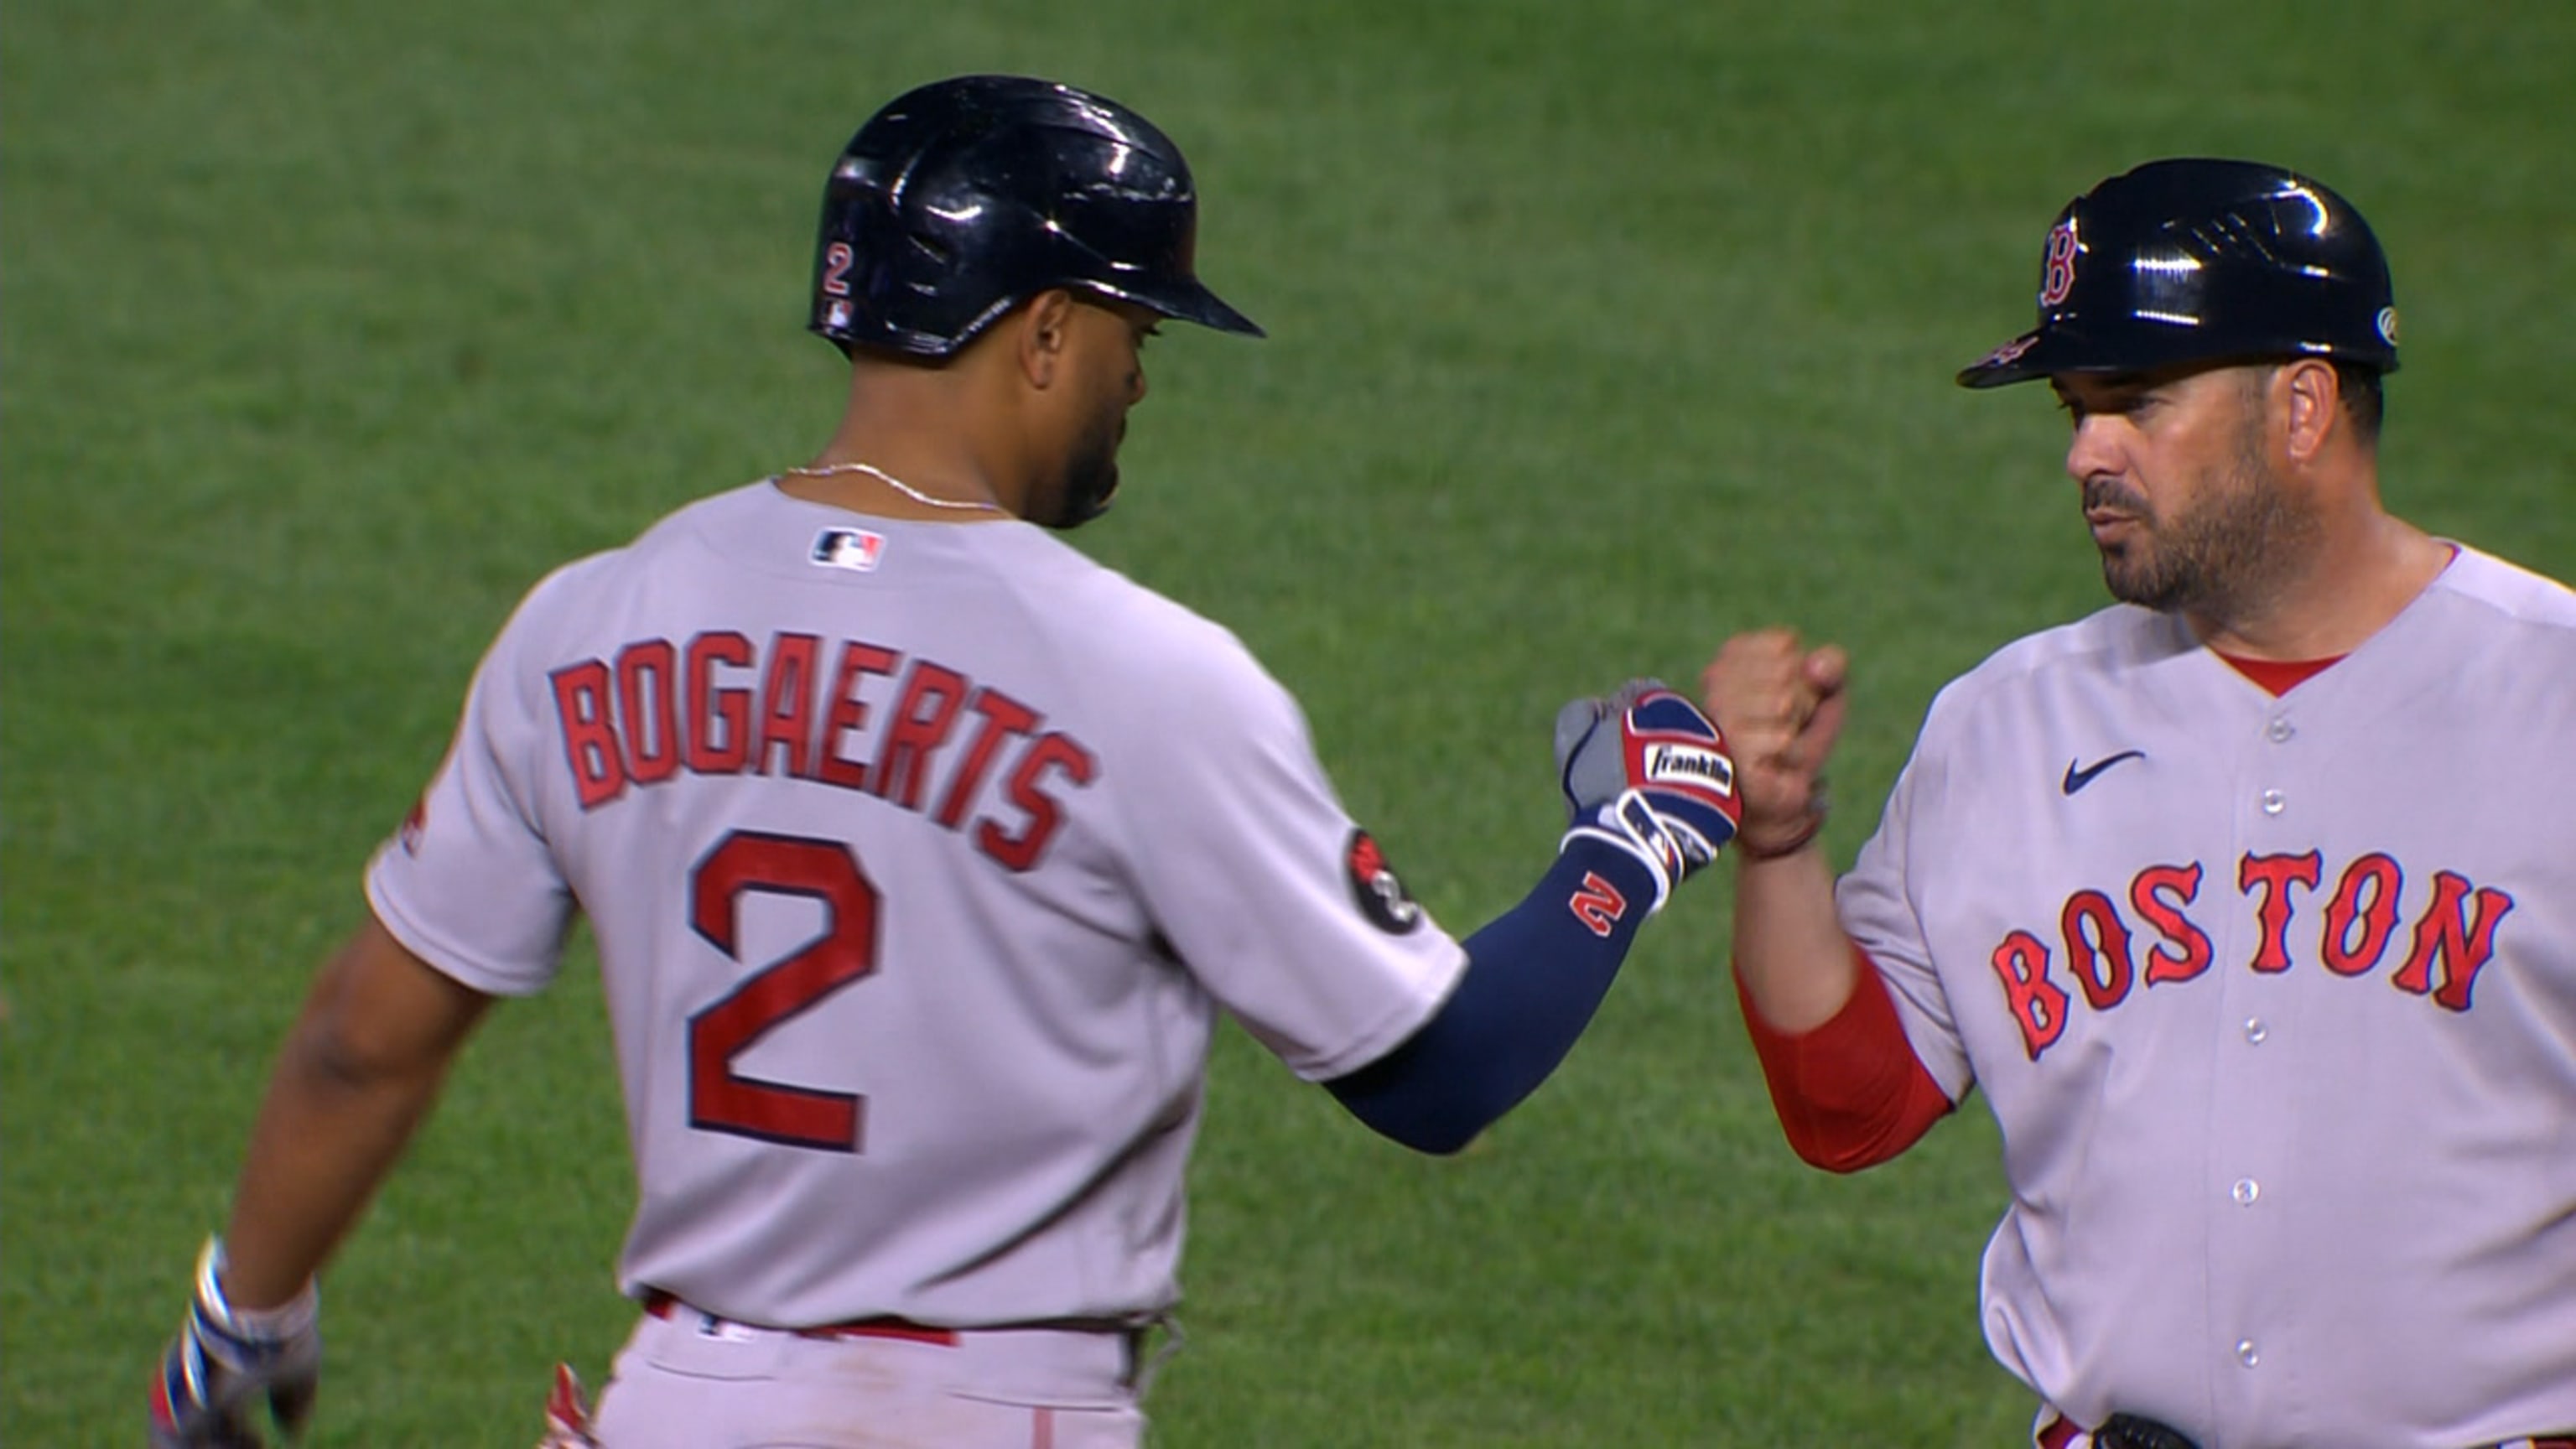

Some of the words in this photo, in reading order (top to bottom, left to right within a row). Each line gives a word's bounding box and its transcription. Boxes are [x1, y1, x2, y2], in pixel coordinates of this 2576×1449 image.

[824, 242, 854, 294] 2
[2040, 223, 2077, 307] B
[548, 631, 1098, 872] BOGAERTS
[1569, 870, 1627, 937] 2
[1992, 849, 2514, 1062] BOSTON
[687, 829, 884, 1154] 2
